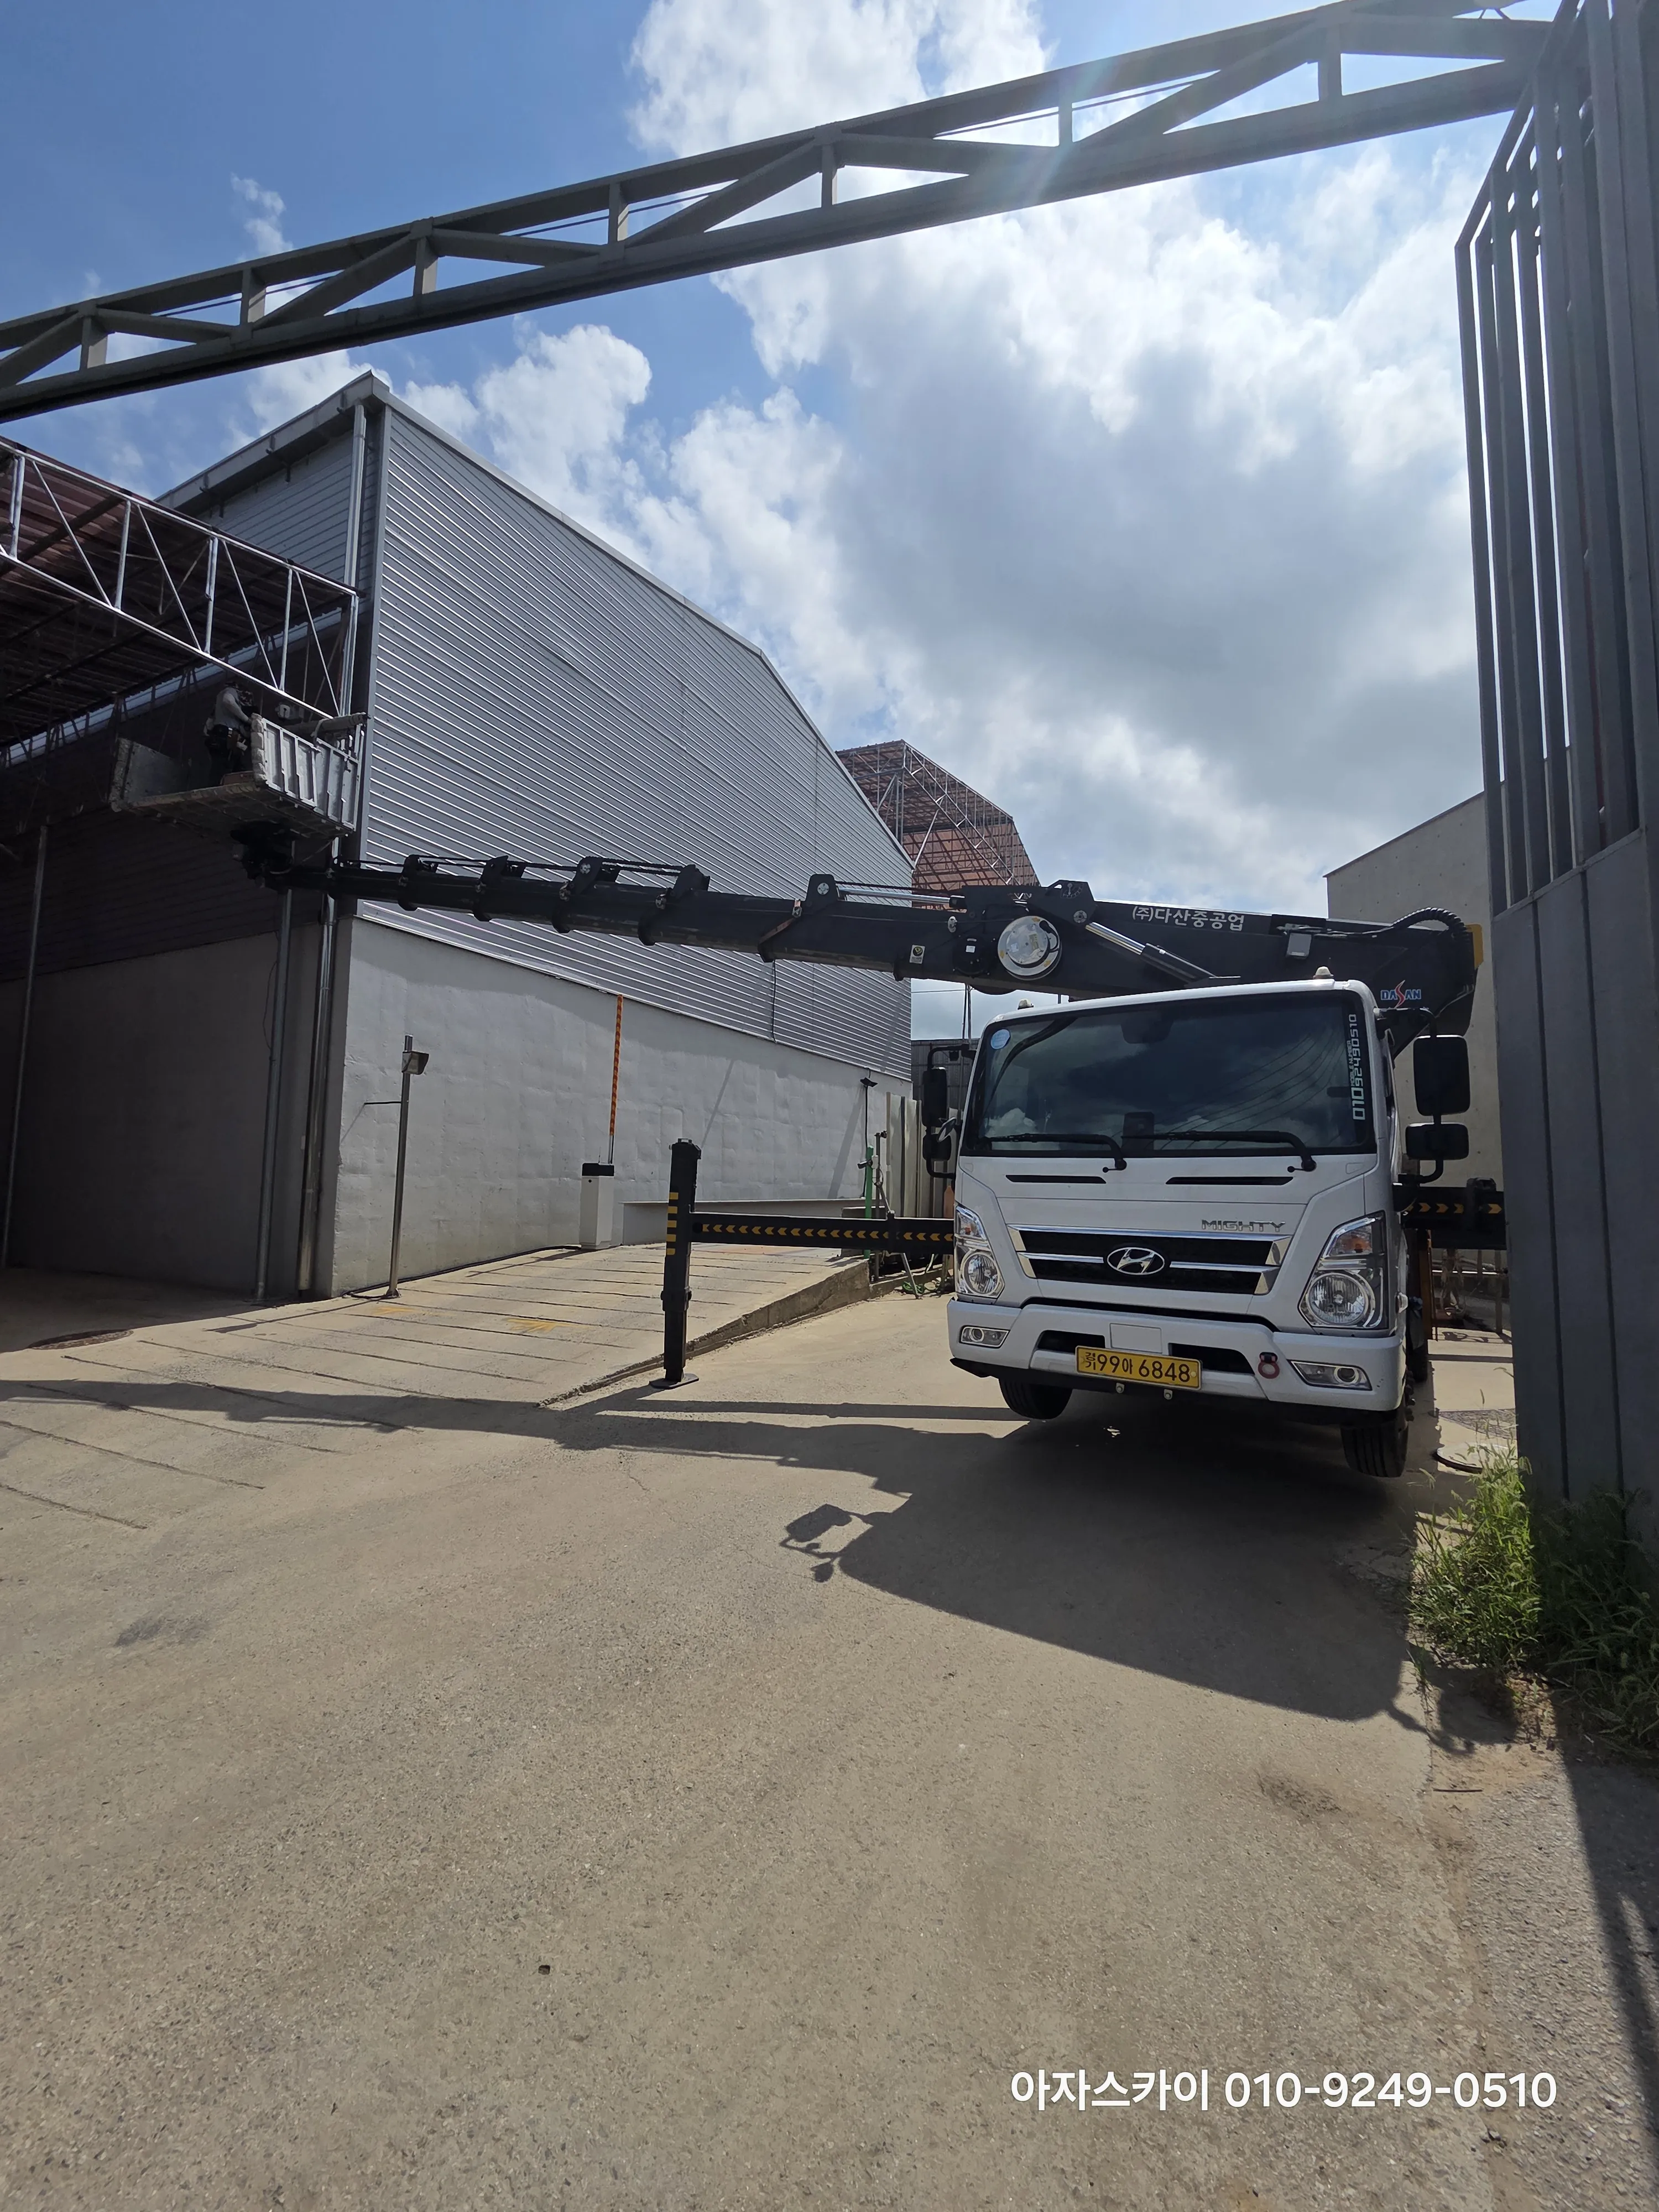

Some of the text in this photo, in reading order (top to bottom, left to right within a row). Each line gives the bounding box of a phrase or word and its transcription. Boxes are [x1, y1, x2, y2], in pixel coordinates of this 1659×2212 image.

[1132, 906, 1244, 931] (주)다산중공업
[1380, 980, 1422, 1009] DASAN
[1201, 1219, 1286, 1233] MIGHTY
[1138, 1359, 1190, 1383] 6848
